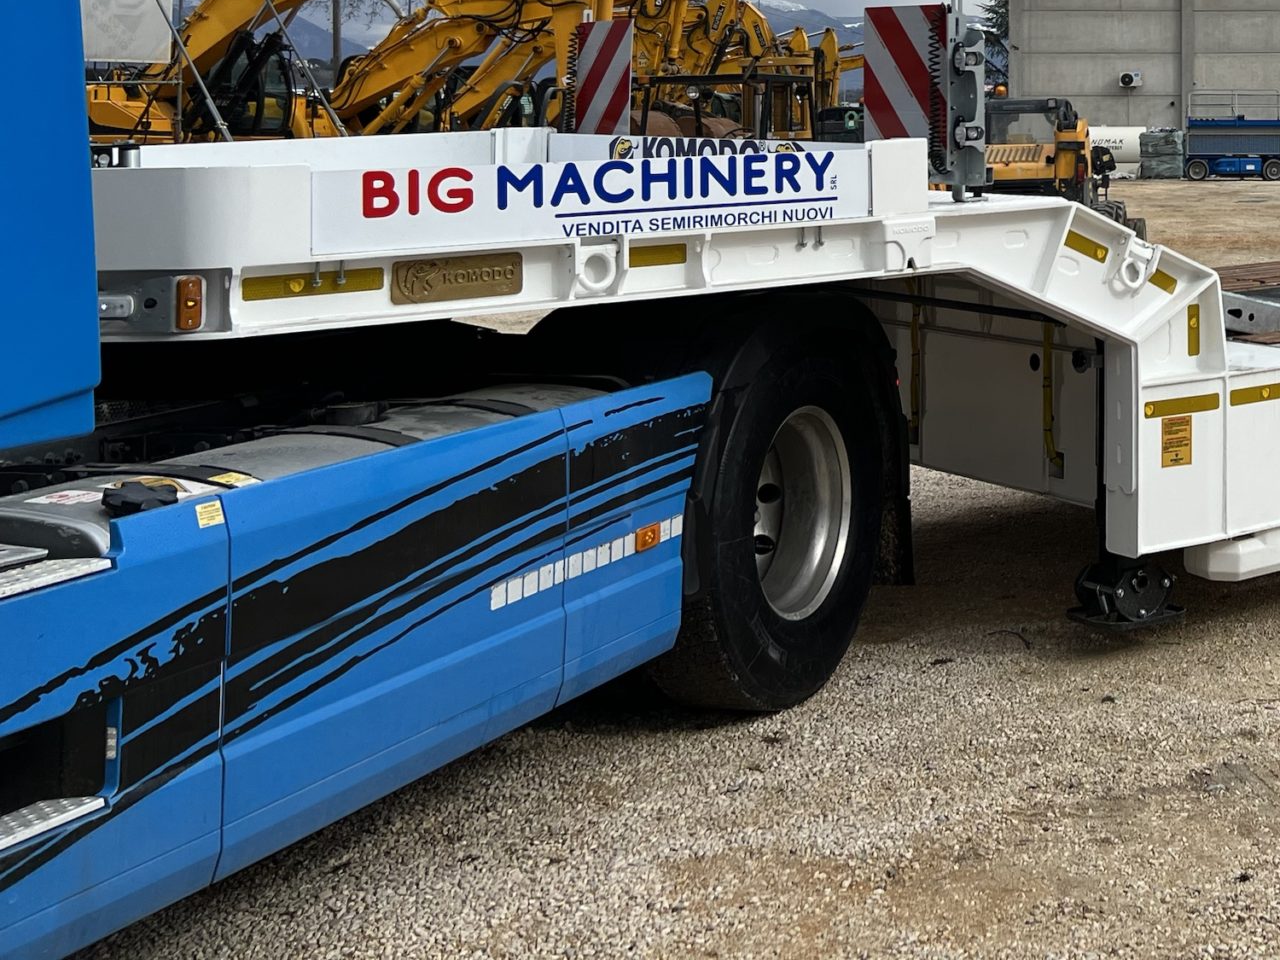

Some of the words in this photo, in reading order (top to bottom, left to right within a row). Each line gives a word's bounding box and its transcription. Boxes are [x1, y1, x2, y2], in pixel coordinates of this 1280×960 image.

[362, 167, 474, 218] BIG
[497, 151, 834, 210] MACHINERY
[830, 174, 838, 190] SRL
[562, 219, 644, 238] VENDITA
[649, 209, 777, 231] SEMIRIMORCHI
[783, 206, 833, 222] NUOVI
[442, 265, 515, 286] KOMODO
